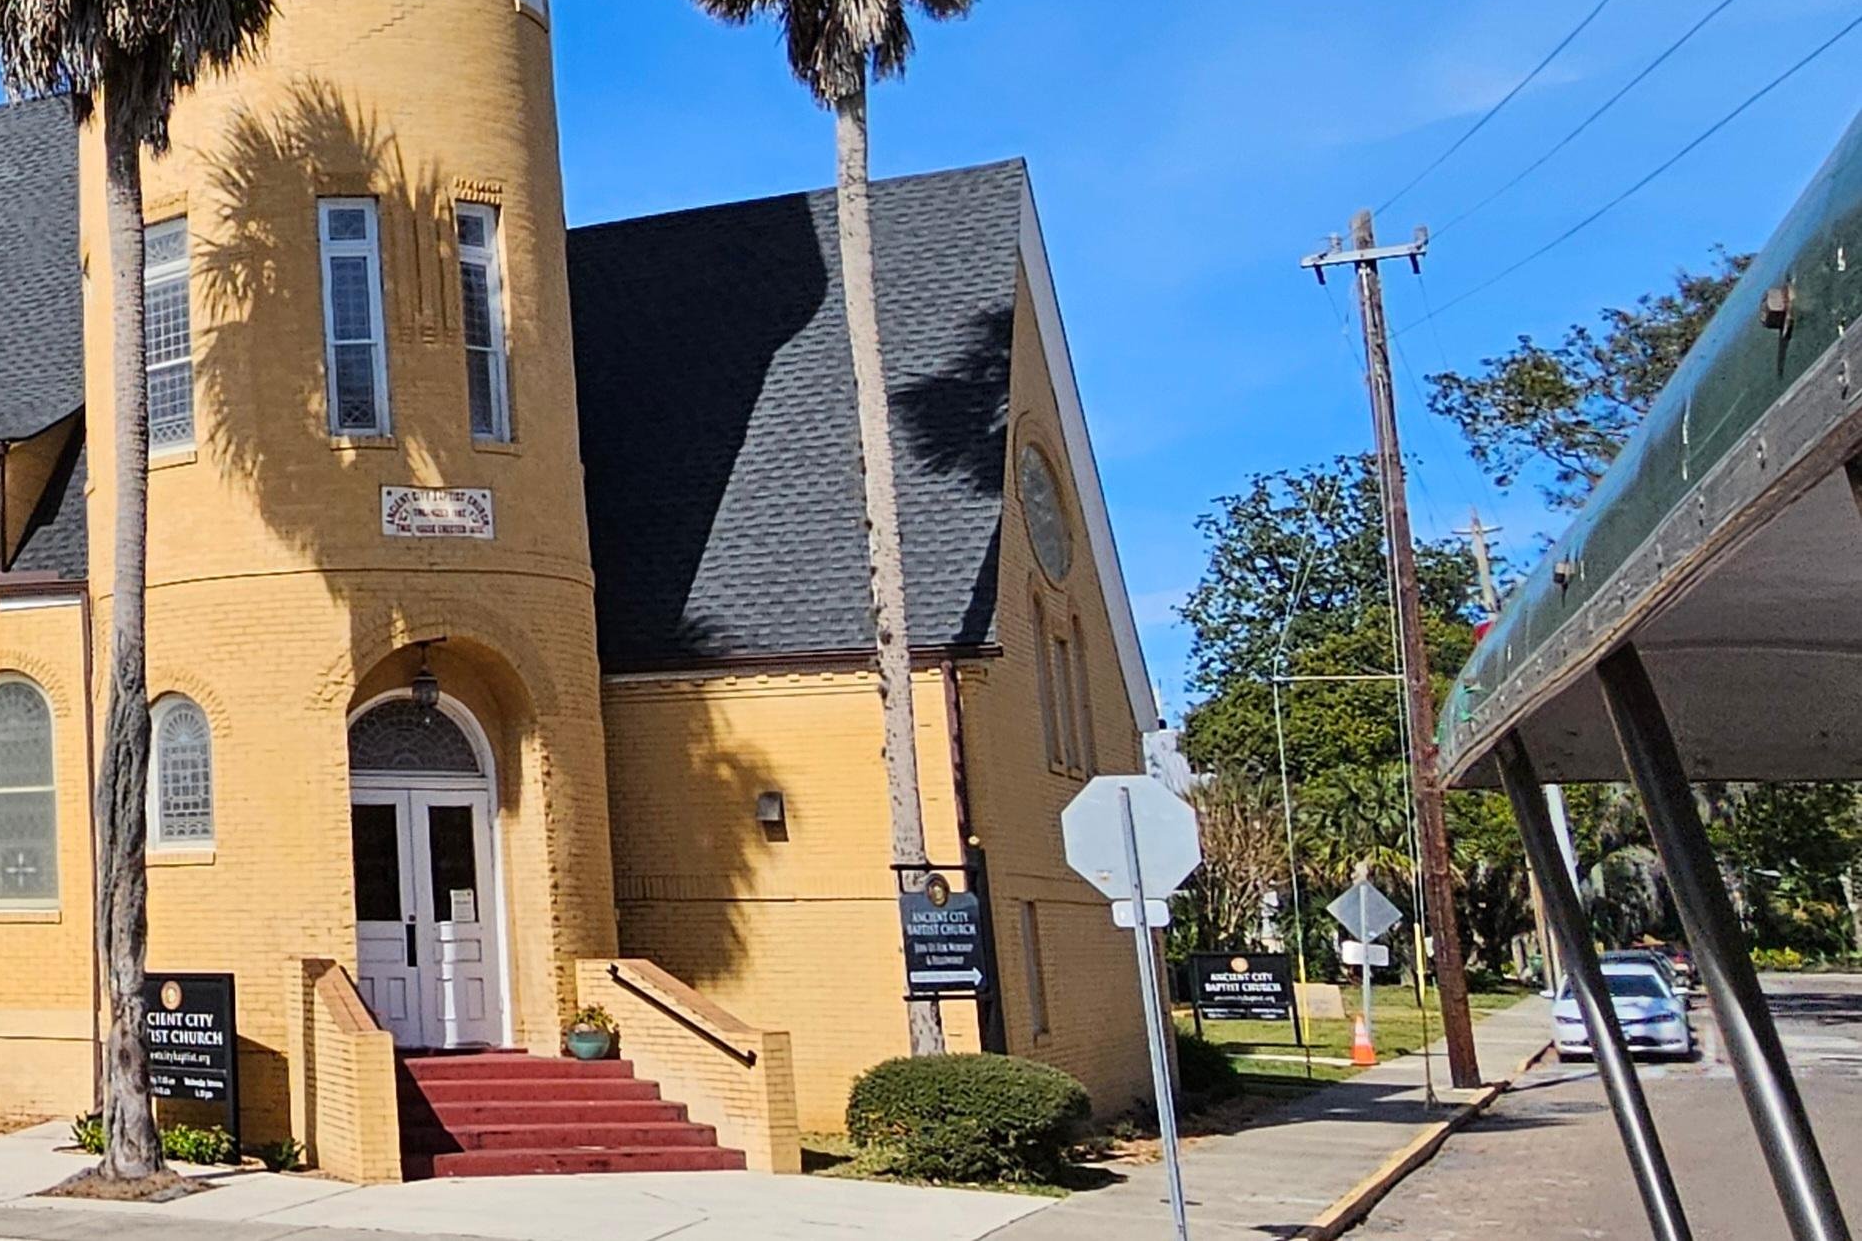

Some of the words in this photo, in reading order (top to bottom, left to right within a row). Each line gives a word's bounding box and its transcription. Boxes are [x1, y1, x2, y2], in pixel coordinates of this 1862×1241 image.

[912, 911, 948, 923] ANCIENT
[949, 911, 969, 923] CITY
[907, 923, 939, 936] BAPTIST
[940, 923, 976, 936] CHURCH
[147, 1012, 184, 1026] CIENT
[185, 1013, 214, 1028] CITY
[170, 1029, 224, 1046] CHURCH
